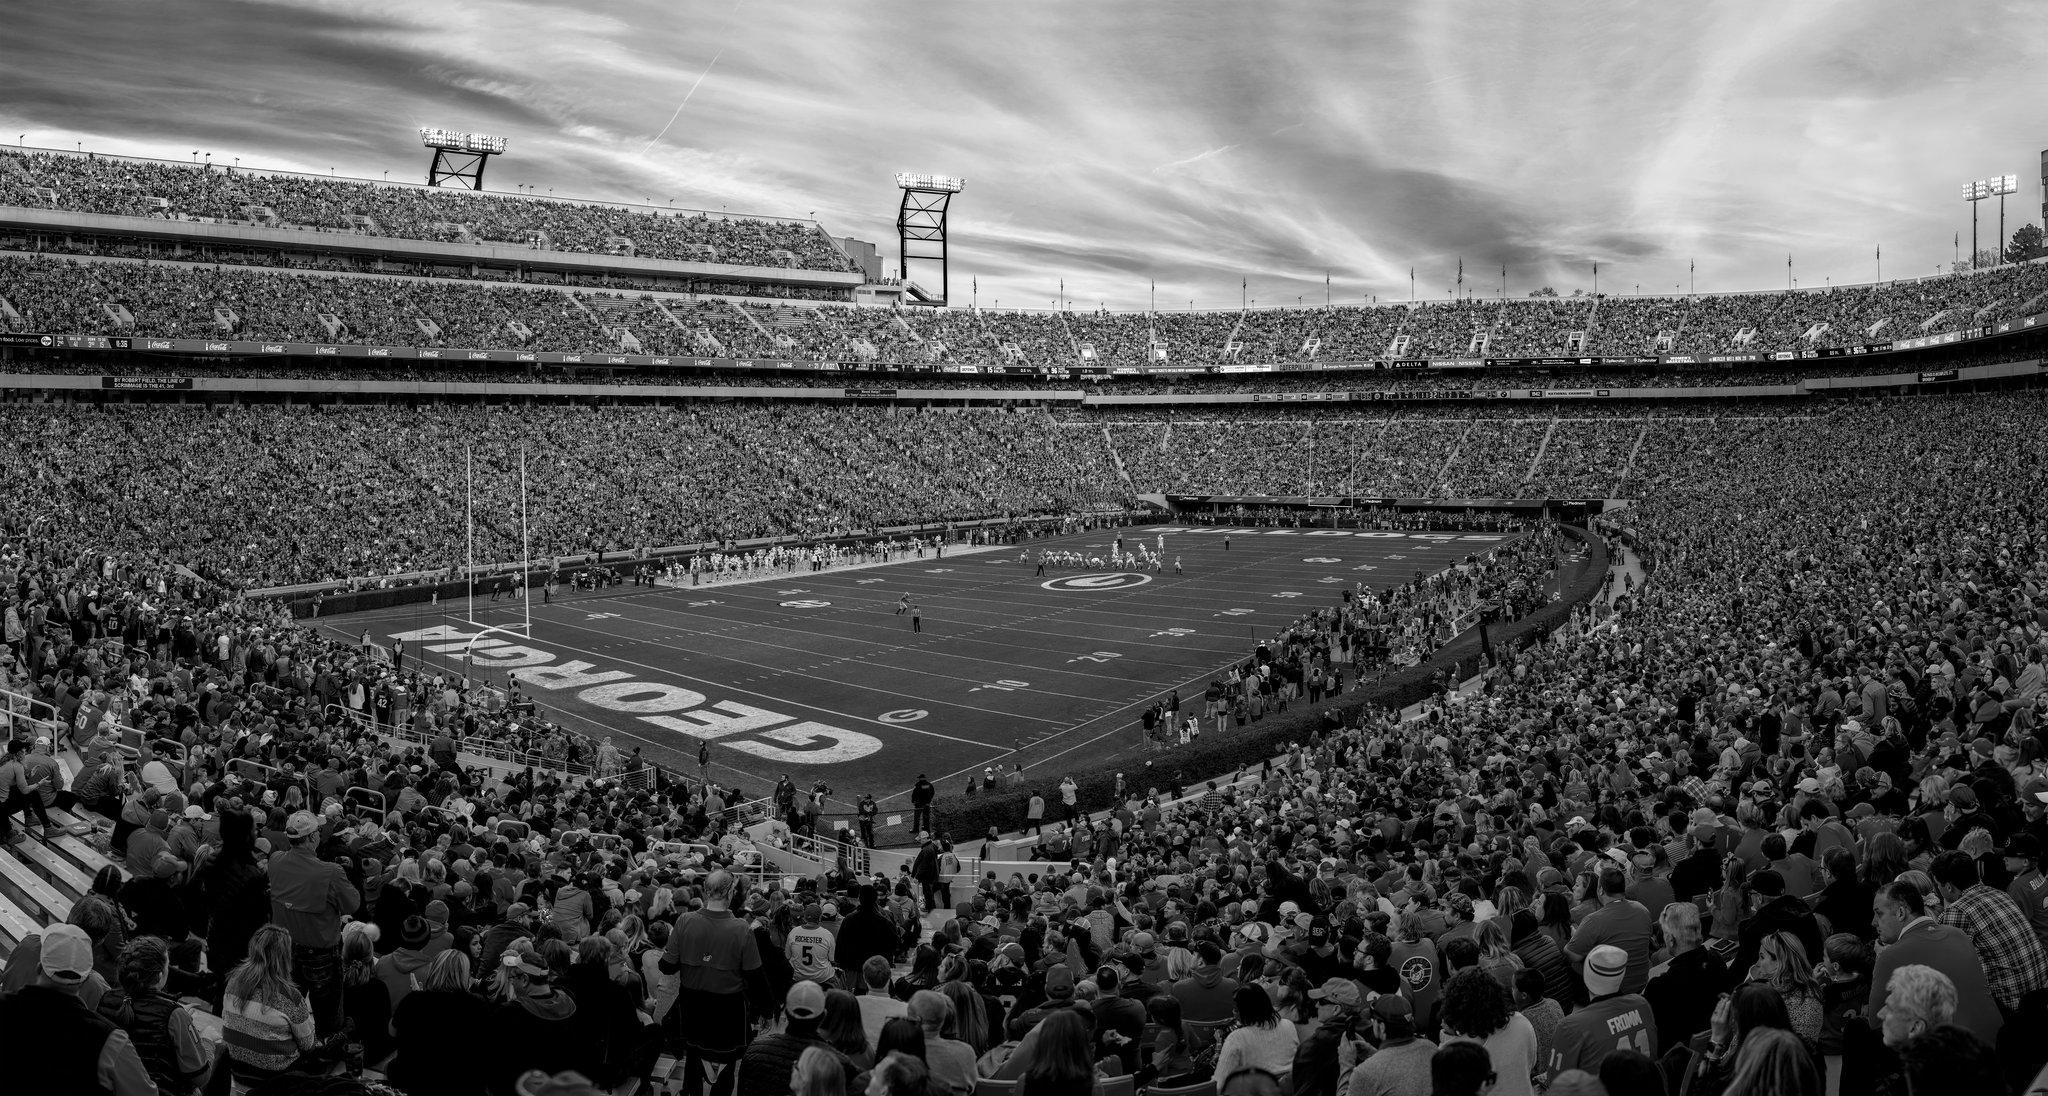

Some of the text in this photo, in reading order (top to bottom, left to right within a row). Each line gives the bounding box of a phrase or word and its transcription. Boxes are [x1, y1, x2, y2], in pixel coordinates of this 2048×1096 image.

[1279, 363, 1313, 371] CATERPILLAR
[108, 620, 118, 630] 10
[982, 679, 1030, 691] 10
[387, 625, 884, 764] GEORGIA
[377, 699, 388, 709] 42
[794, 935, 823, 944] ROCHESTER
[801, 945, 813, 966] 5
[1606, 1009, 1643, 1035] FROMM
